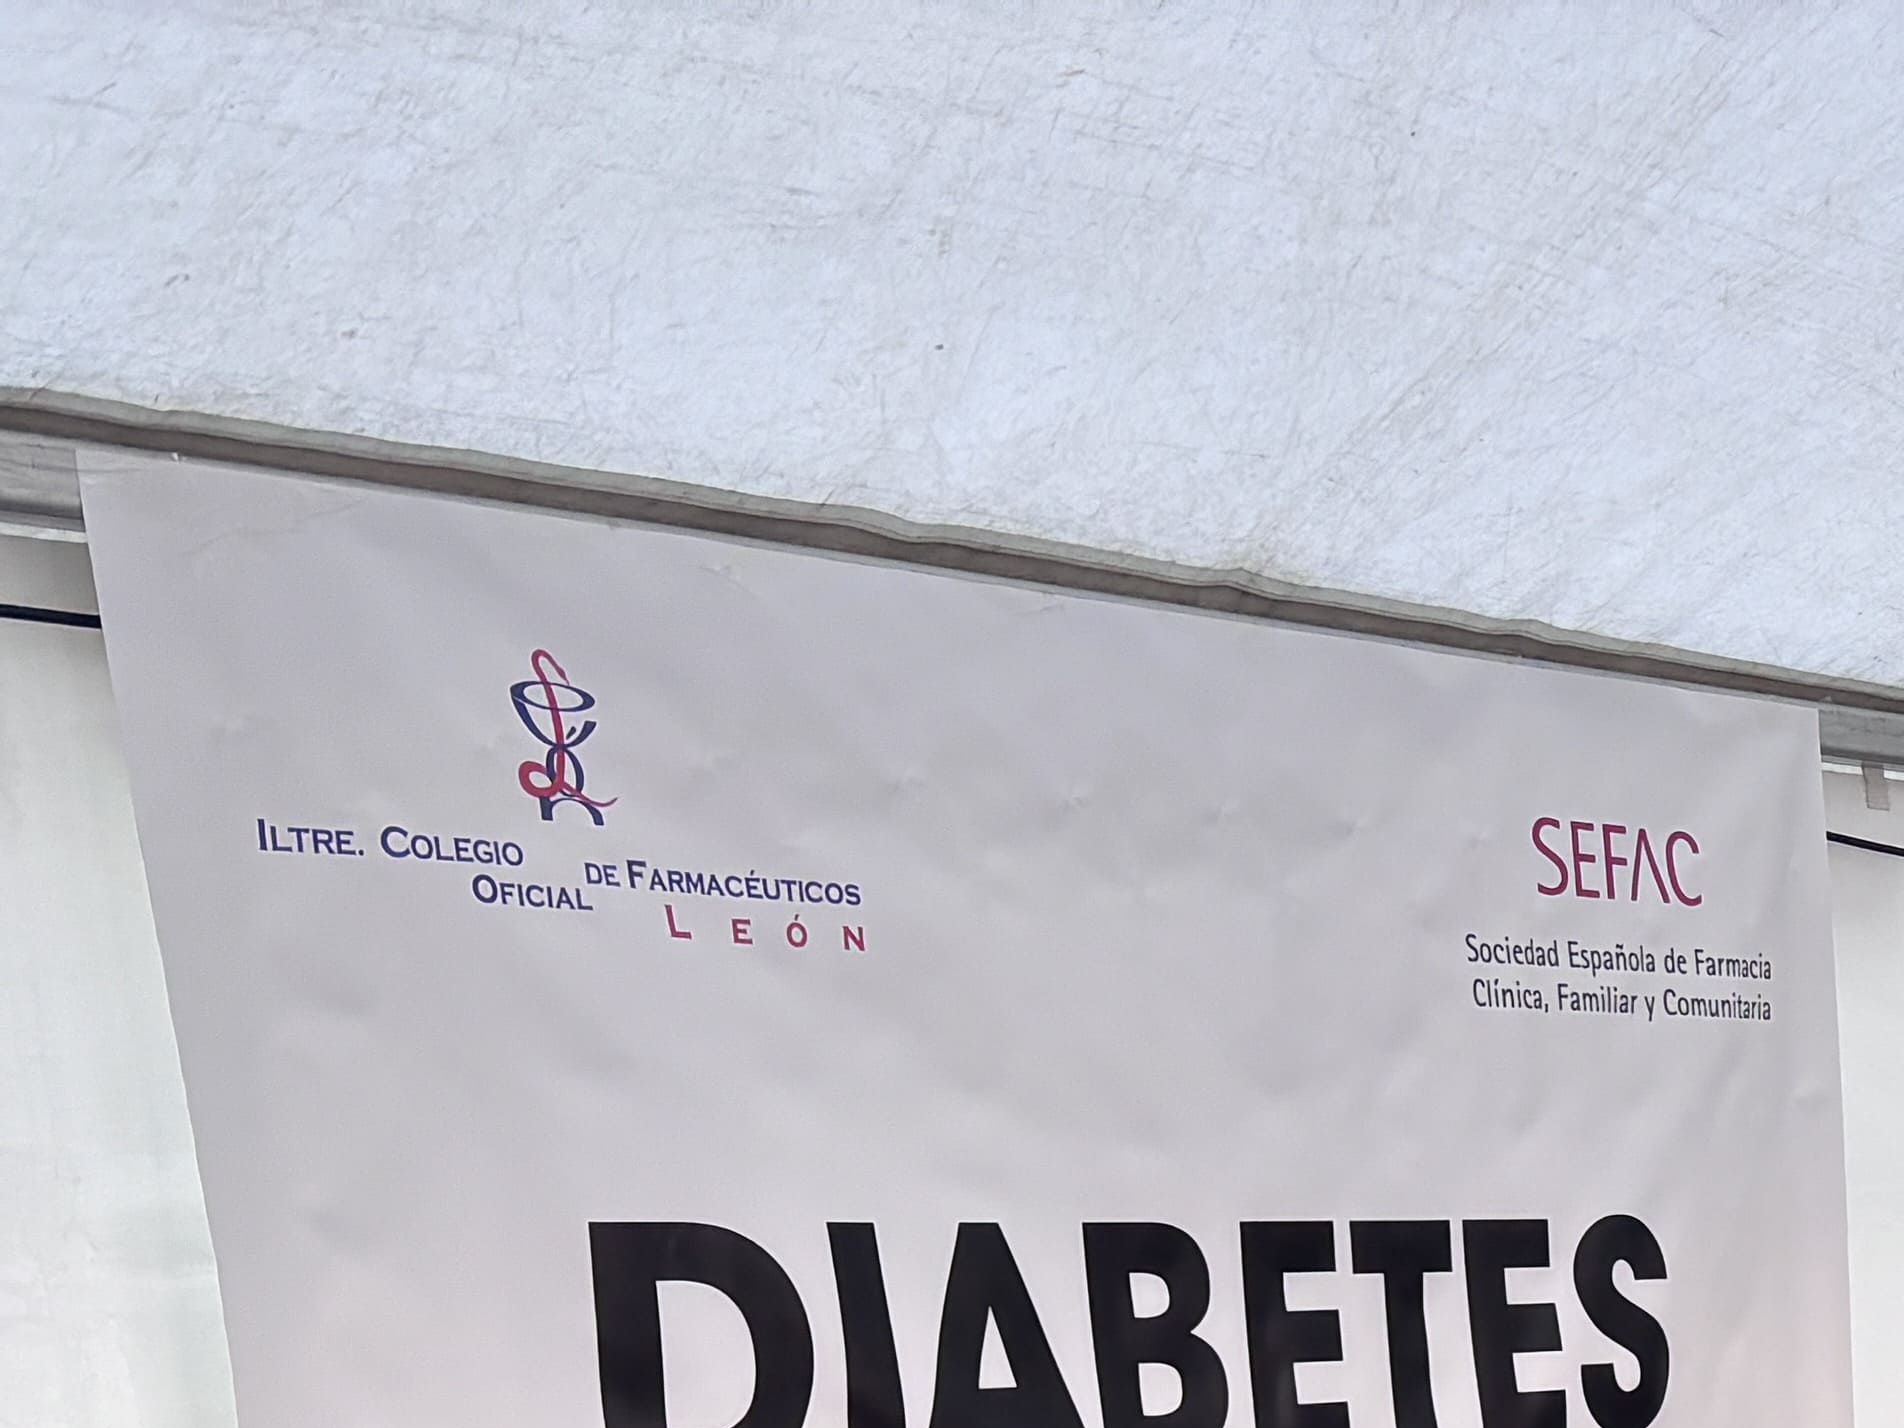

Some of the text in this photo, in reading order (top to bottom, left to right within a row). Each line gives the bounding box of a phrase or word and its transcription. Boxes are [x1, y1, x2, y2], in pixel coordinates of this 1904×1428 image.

[379, 824, 525, 867] COLEGIO
[1531, 816, 1703, 908] SEFAC
[471, 873, 594, 912] OFICIAL
[626, 859, 862, 907] FARMACÉUTICOS
[1464, 933, 1773, 981] Sociedad Española de Farmacia
[1472, 978, 1772, 1023] Clínica, Familiar y Comunitaria
